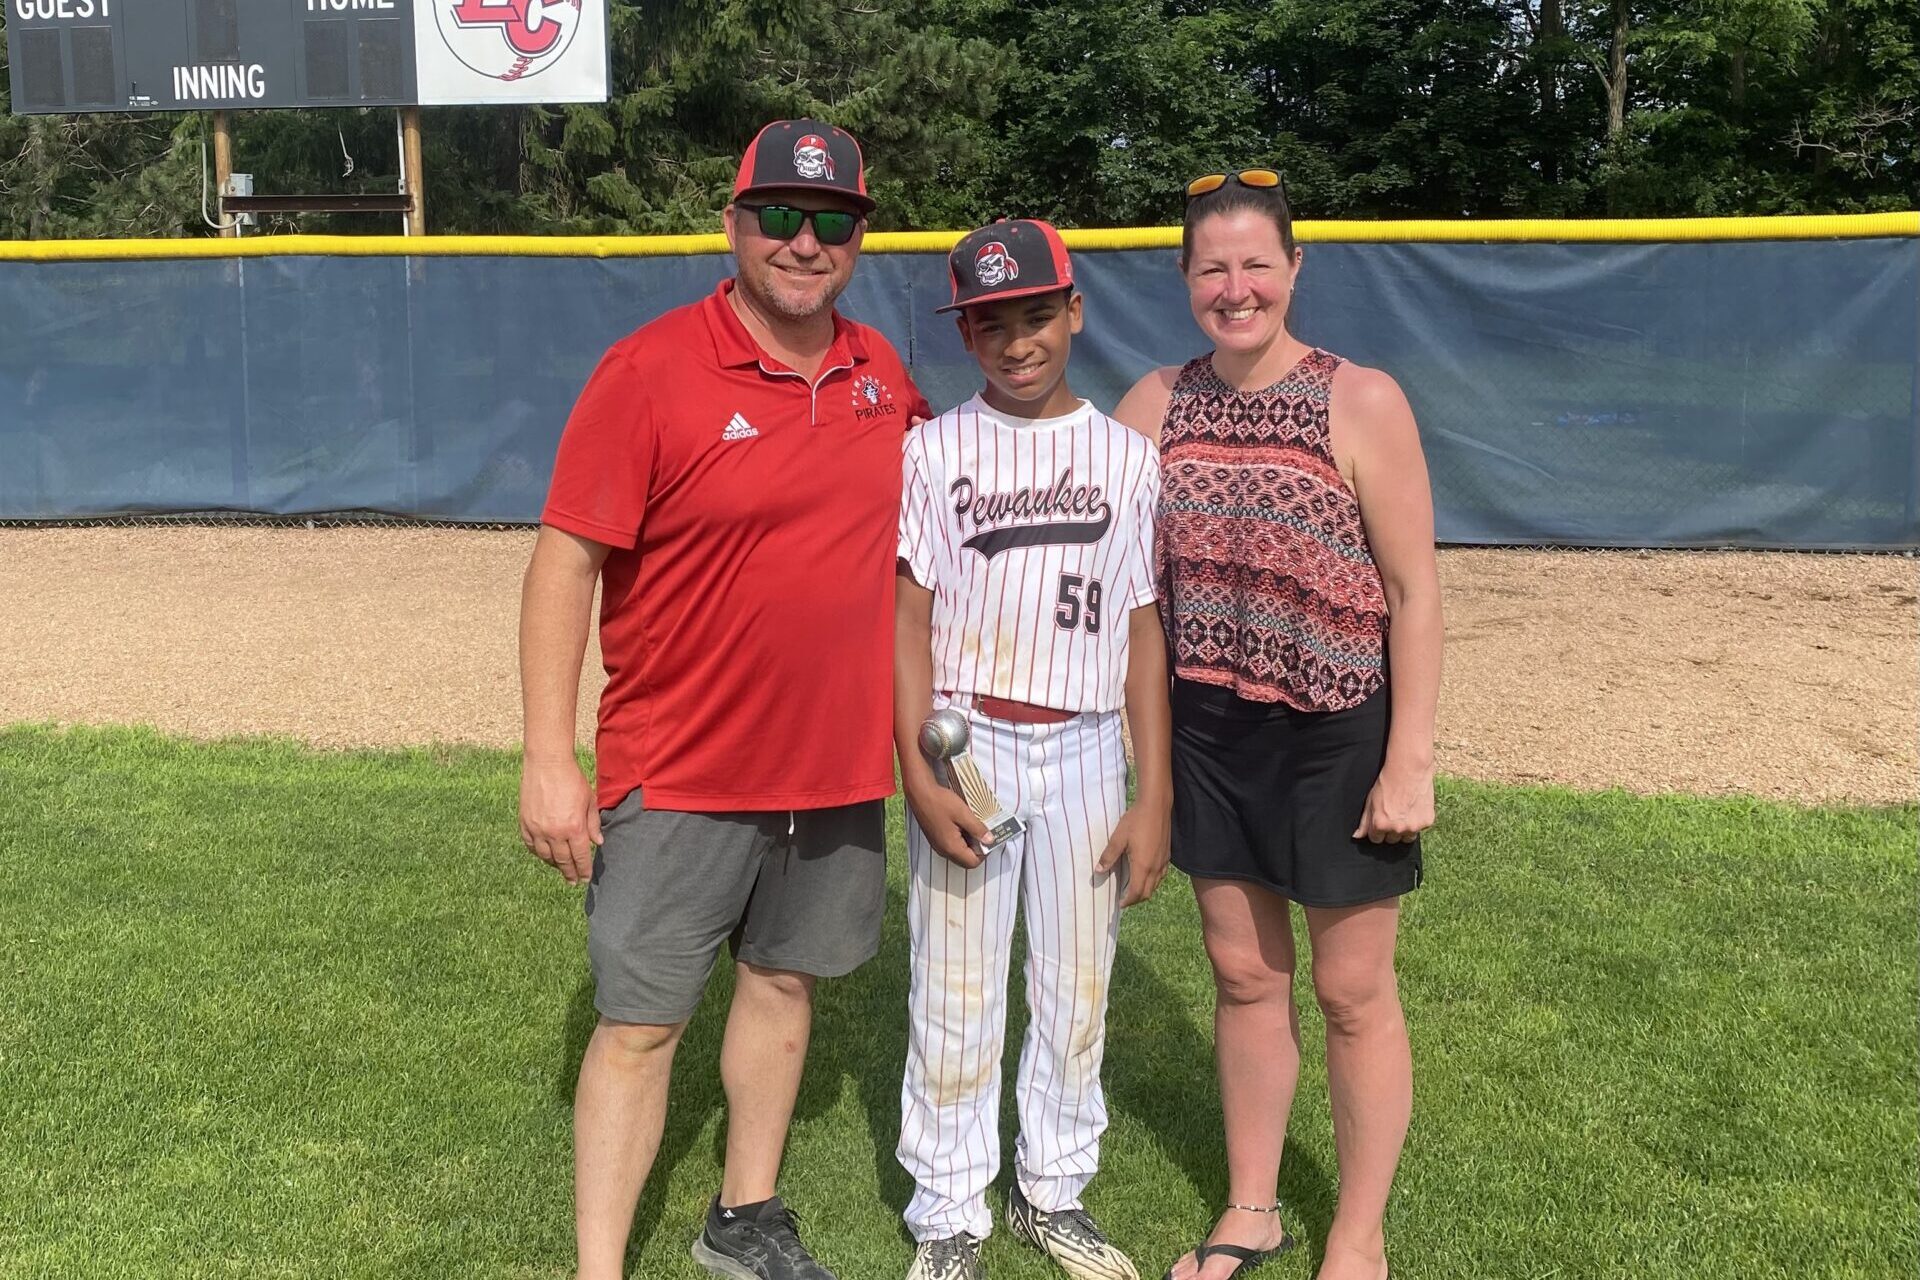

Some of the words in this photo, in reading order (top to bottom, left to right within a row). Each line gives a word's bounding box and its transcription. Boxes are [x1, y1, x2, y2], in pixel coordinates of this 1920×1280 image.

[173, 64, 265, 100] INNING
[855, 403, 897, 421] PIRATES
[722, 427, 759, 441] adidas
[950, 467, 1102, 531] Pewaukee
[1053, 571, 1103, 636] 59
